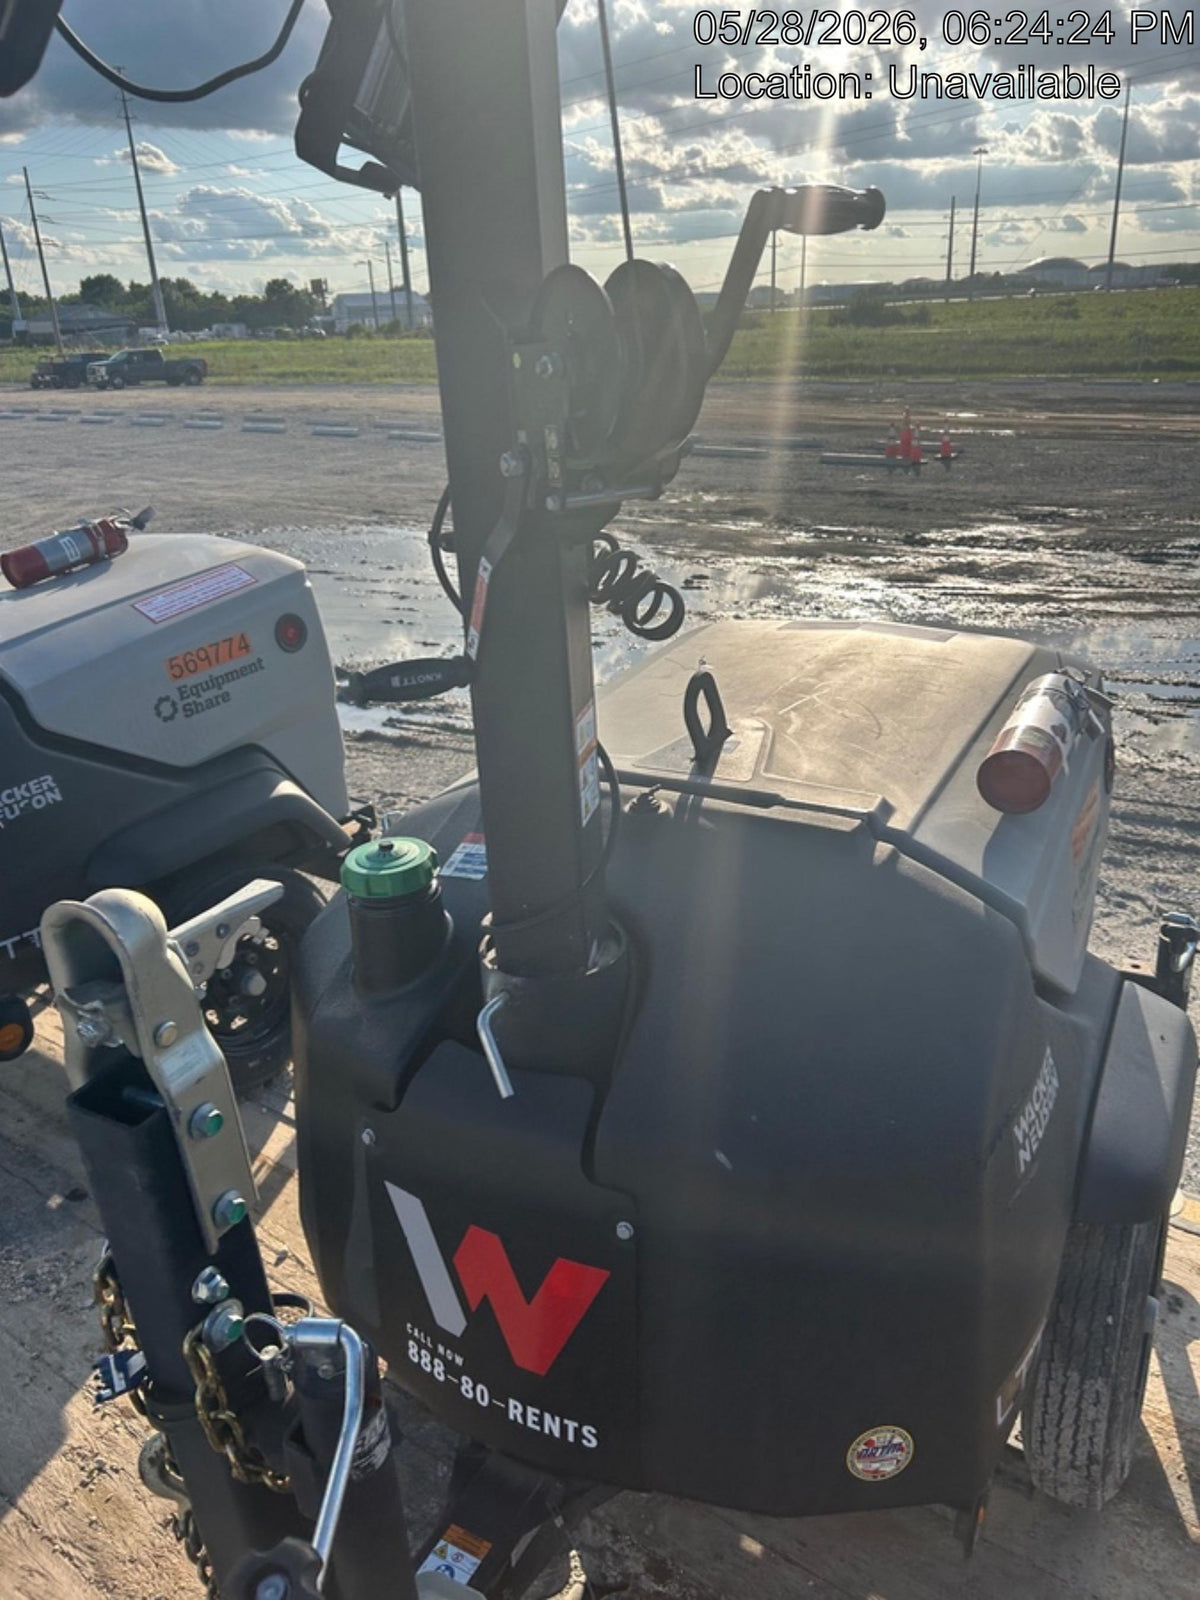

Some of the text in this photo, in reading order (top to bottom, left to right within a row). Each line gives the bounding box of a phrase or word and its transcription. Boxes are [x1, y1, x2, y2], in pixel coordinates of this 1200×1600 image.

[168, 633, 251, 680] 569774
[176, 656, 265, 702] Equipment
[182, 690, 231, 719] Share
[0, 774, 57, 806] CKER
[406, 1322, 464, 1367] CALL NOW
[407, 1339, 600, 1449] 888-80-RENTS
